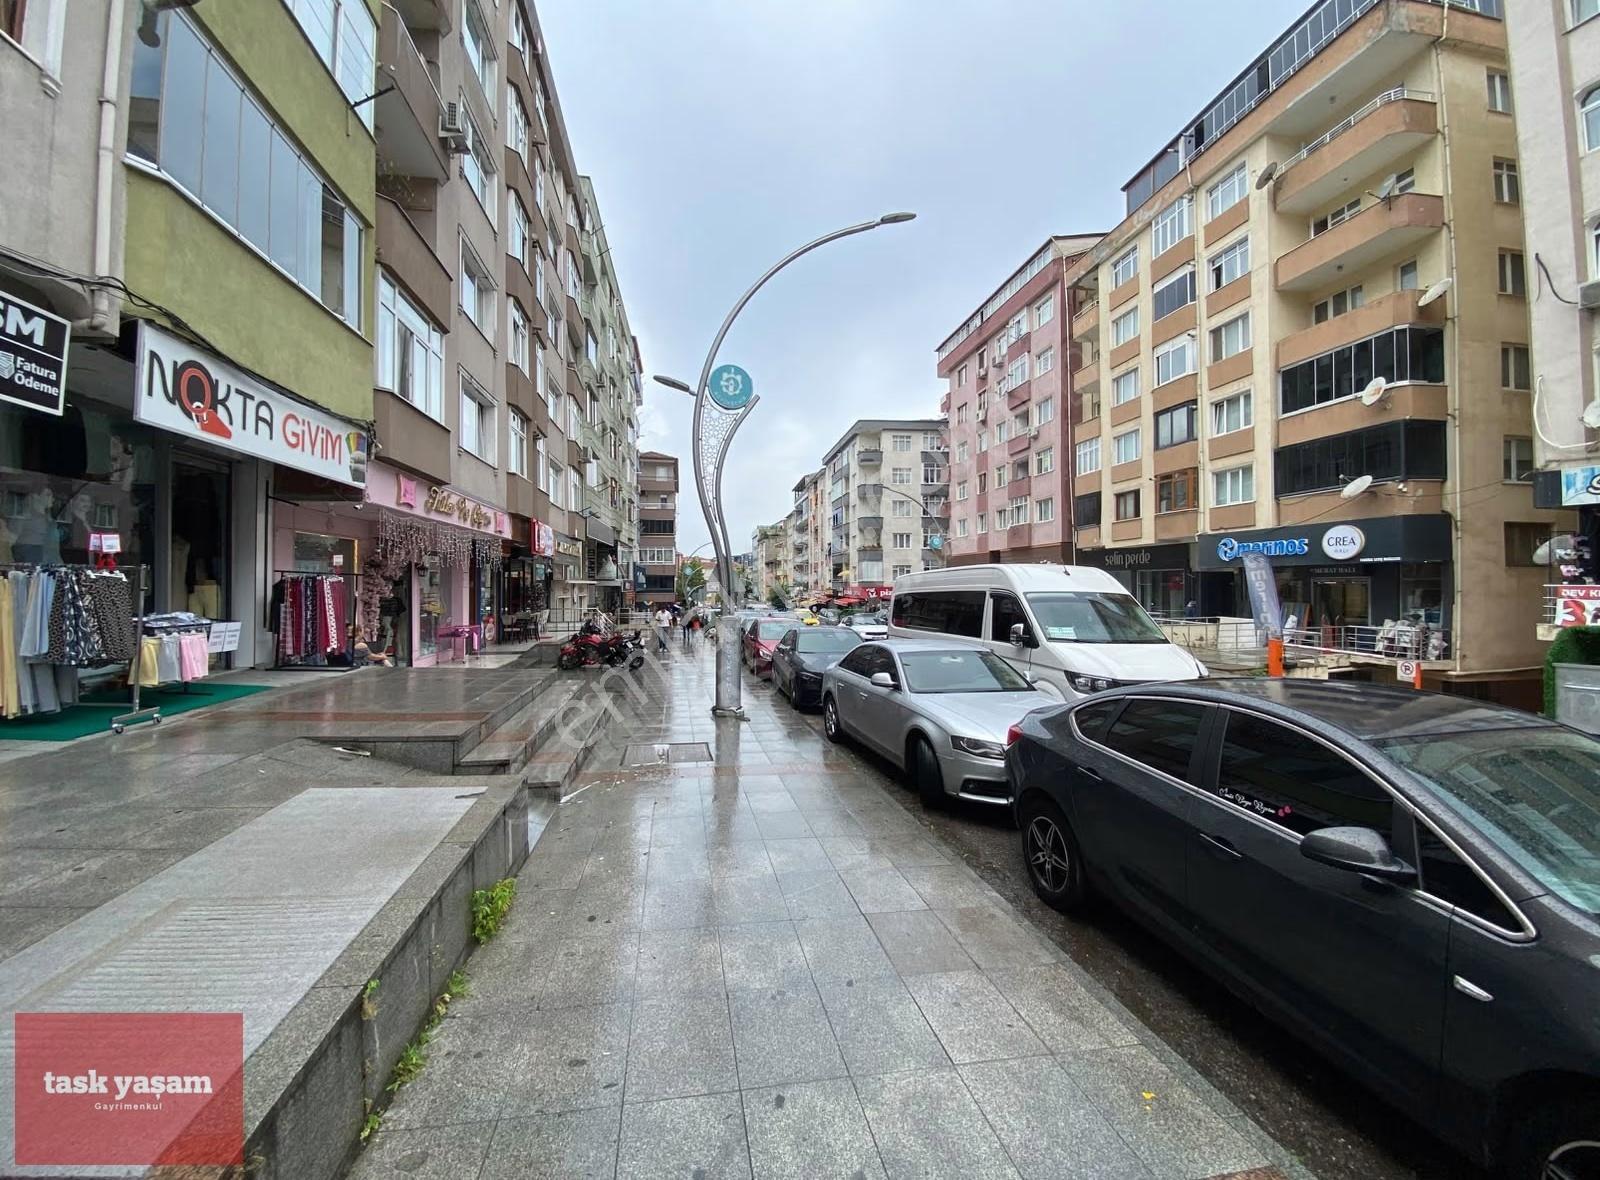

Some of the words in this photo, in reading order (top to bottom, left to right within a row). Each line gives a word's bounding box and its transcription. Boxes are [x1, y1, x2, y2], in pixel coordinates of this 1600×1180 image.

[0, 298, 46, 347] M
[16, 356, 57, 381] Fatura
[14, 370, 60, 397] Ödeme
[148, 350, 274, 441] NOKTA
[1236, 538, 1309, 557] merinos
[1327, 536, 1356, 547] CREA
[1105, 551, 1124, 566] selin
[1125, 549, 1151, 568] perde
[1561, 589, 1586, 597] DEV
